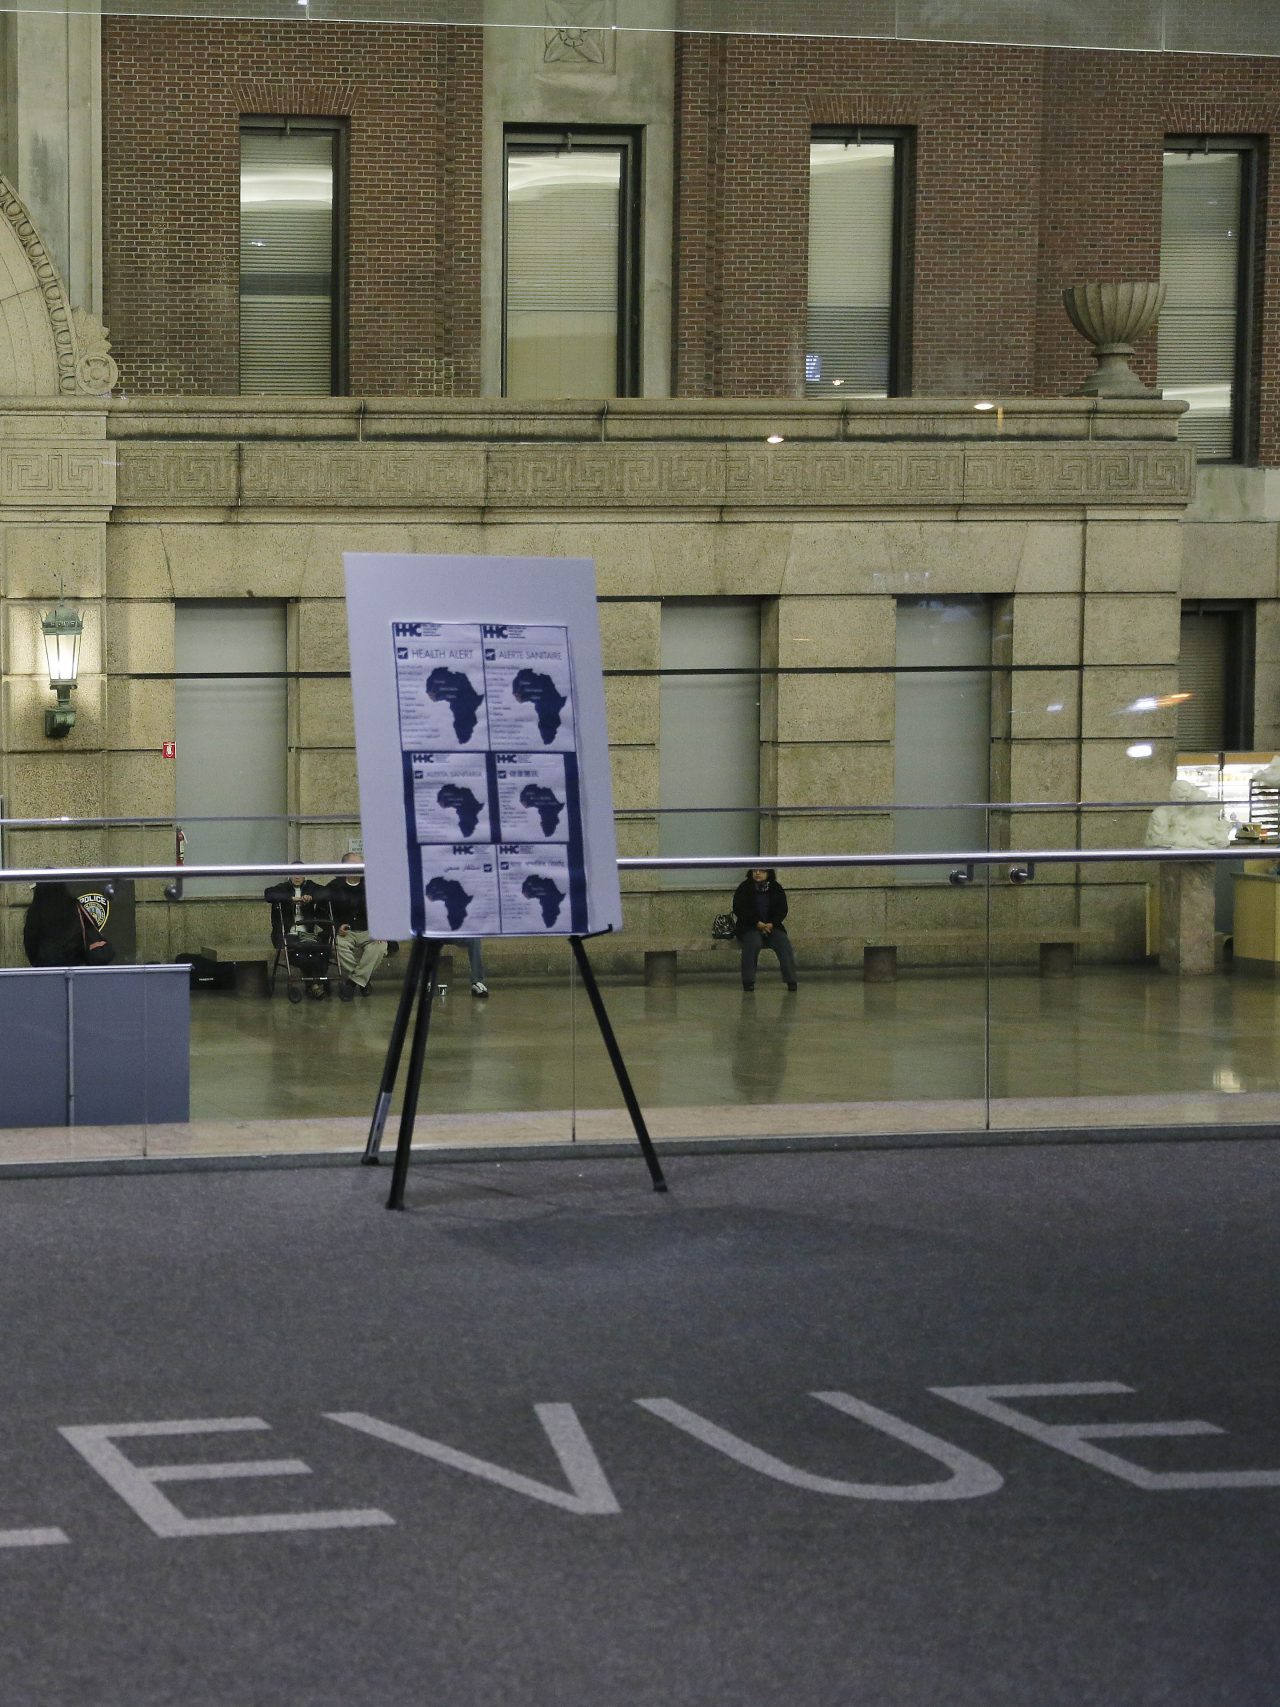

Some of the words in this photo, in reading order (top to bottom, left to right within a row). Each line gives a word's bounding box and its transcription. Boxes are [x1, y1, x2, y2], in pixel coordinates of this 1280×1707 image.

[395, 623, 422, 637] HHC
[483, 625, 508, 639] HHC
[412, 649, 446, 659] HEALTH
[449, 649, 474, 660] ALERT
[499, 649, 523, 660] ALERTE
[526, 651, 562, 661] SANITAIRE
[80, 895, 107, 906] POLICE
